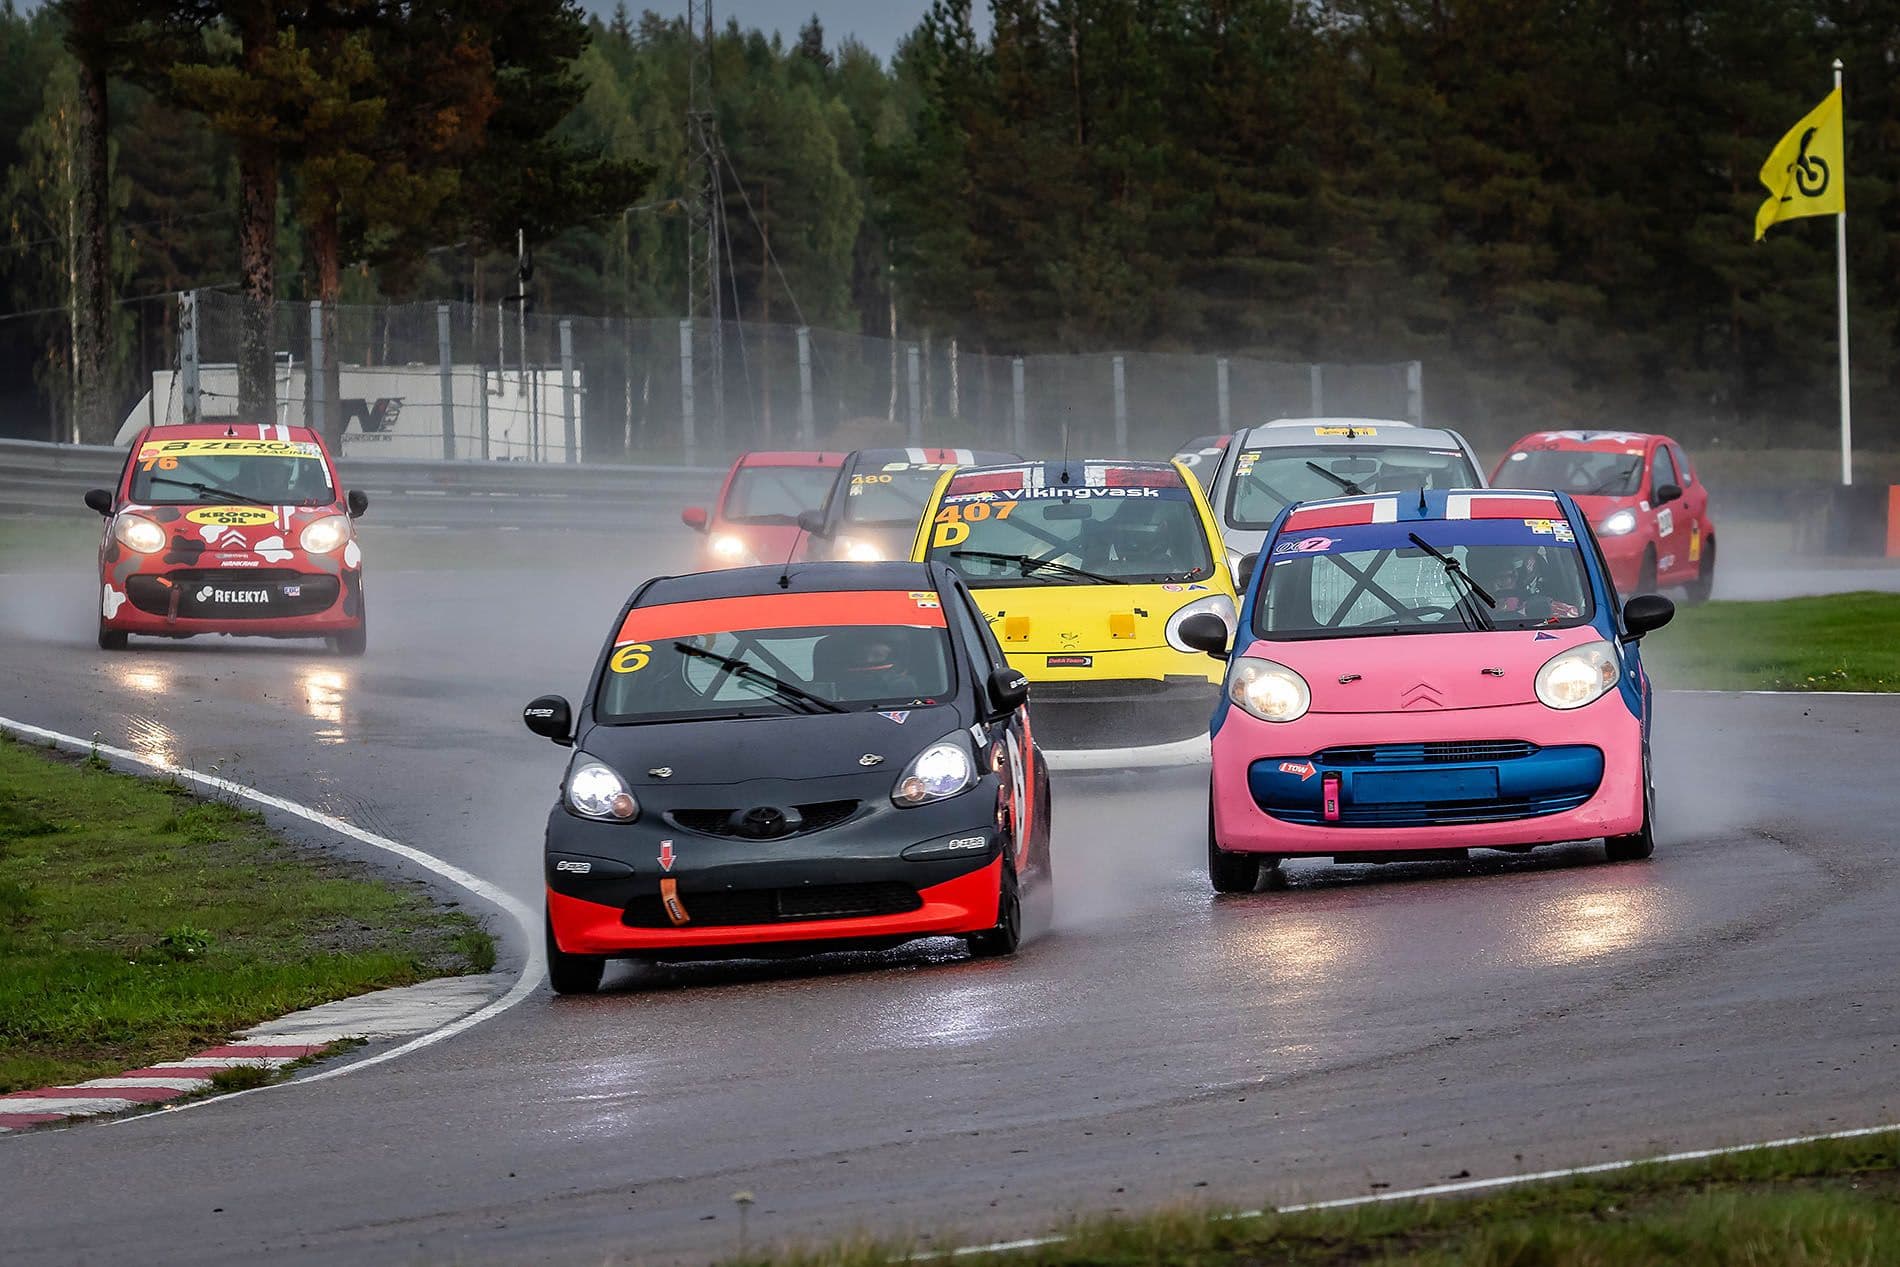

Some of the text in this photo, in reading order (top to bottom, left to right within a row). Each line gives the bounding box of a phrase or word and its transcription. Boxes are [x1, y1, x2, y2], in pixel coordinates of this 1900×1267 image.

[162, 441, 290, 451] B-ZERO
[139, 457, 179, 472] 76
[851, 474, 893, 485] 480
[1003, 487, 1159, 500] Vikingvask
[935, 501, 1018, 524] 407
[932, 522, 970, 548] D
[610, 644, 653, 674] 6
[1287, 764, 1309, 773] TOW
